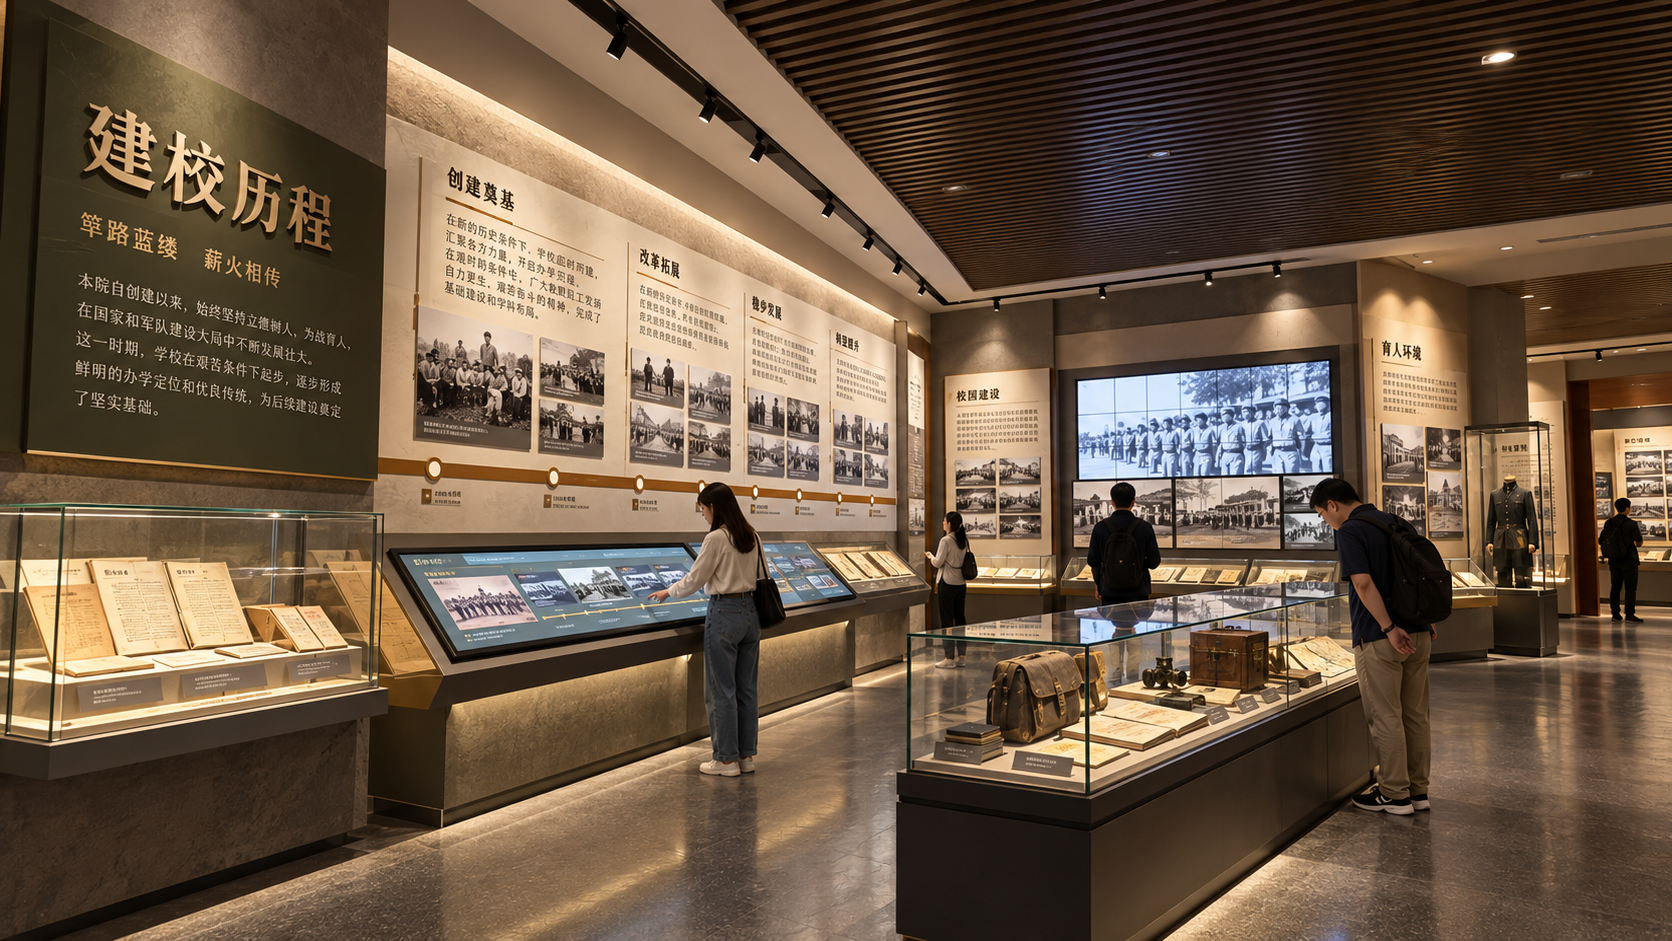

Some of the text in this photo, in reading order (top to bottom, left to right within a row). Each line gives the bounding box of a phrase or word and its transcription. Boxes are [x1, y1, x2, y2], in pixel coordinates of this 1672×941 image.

[83, 102, 332, 252] 建校历程
[447, 166, 515, 212] 创建奠基
[80, 211, 281, 289] 筚路蓝缕 薪火相传
[639, 248, 680, 279] 改革拓展
[1382, 340, 1422, 361] 育人环境
[74, 390, 159, 417] 了坚实基础。
